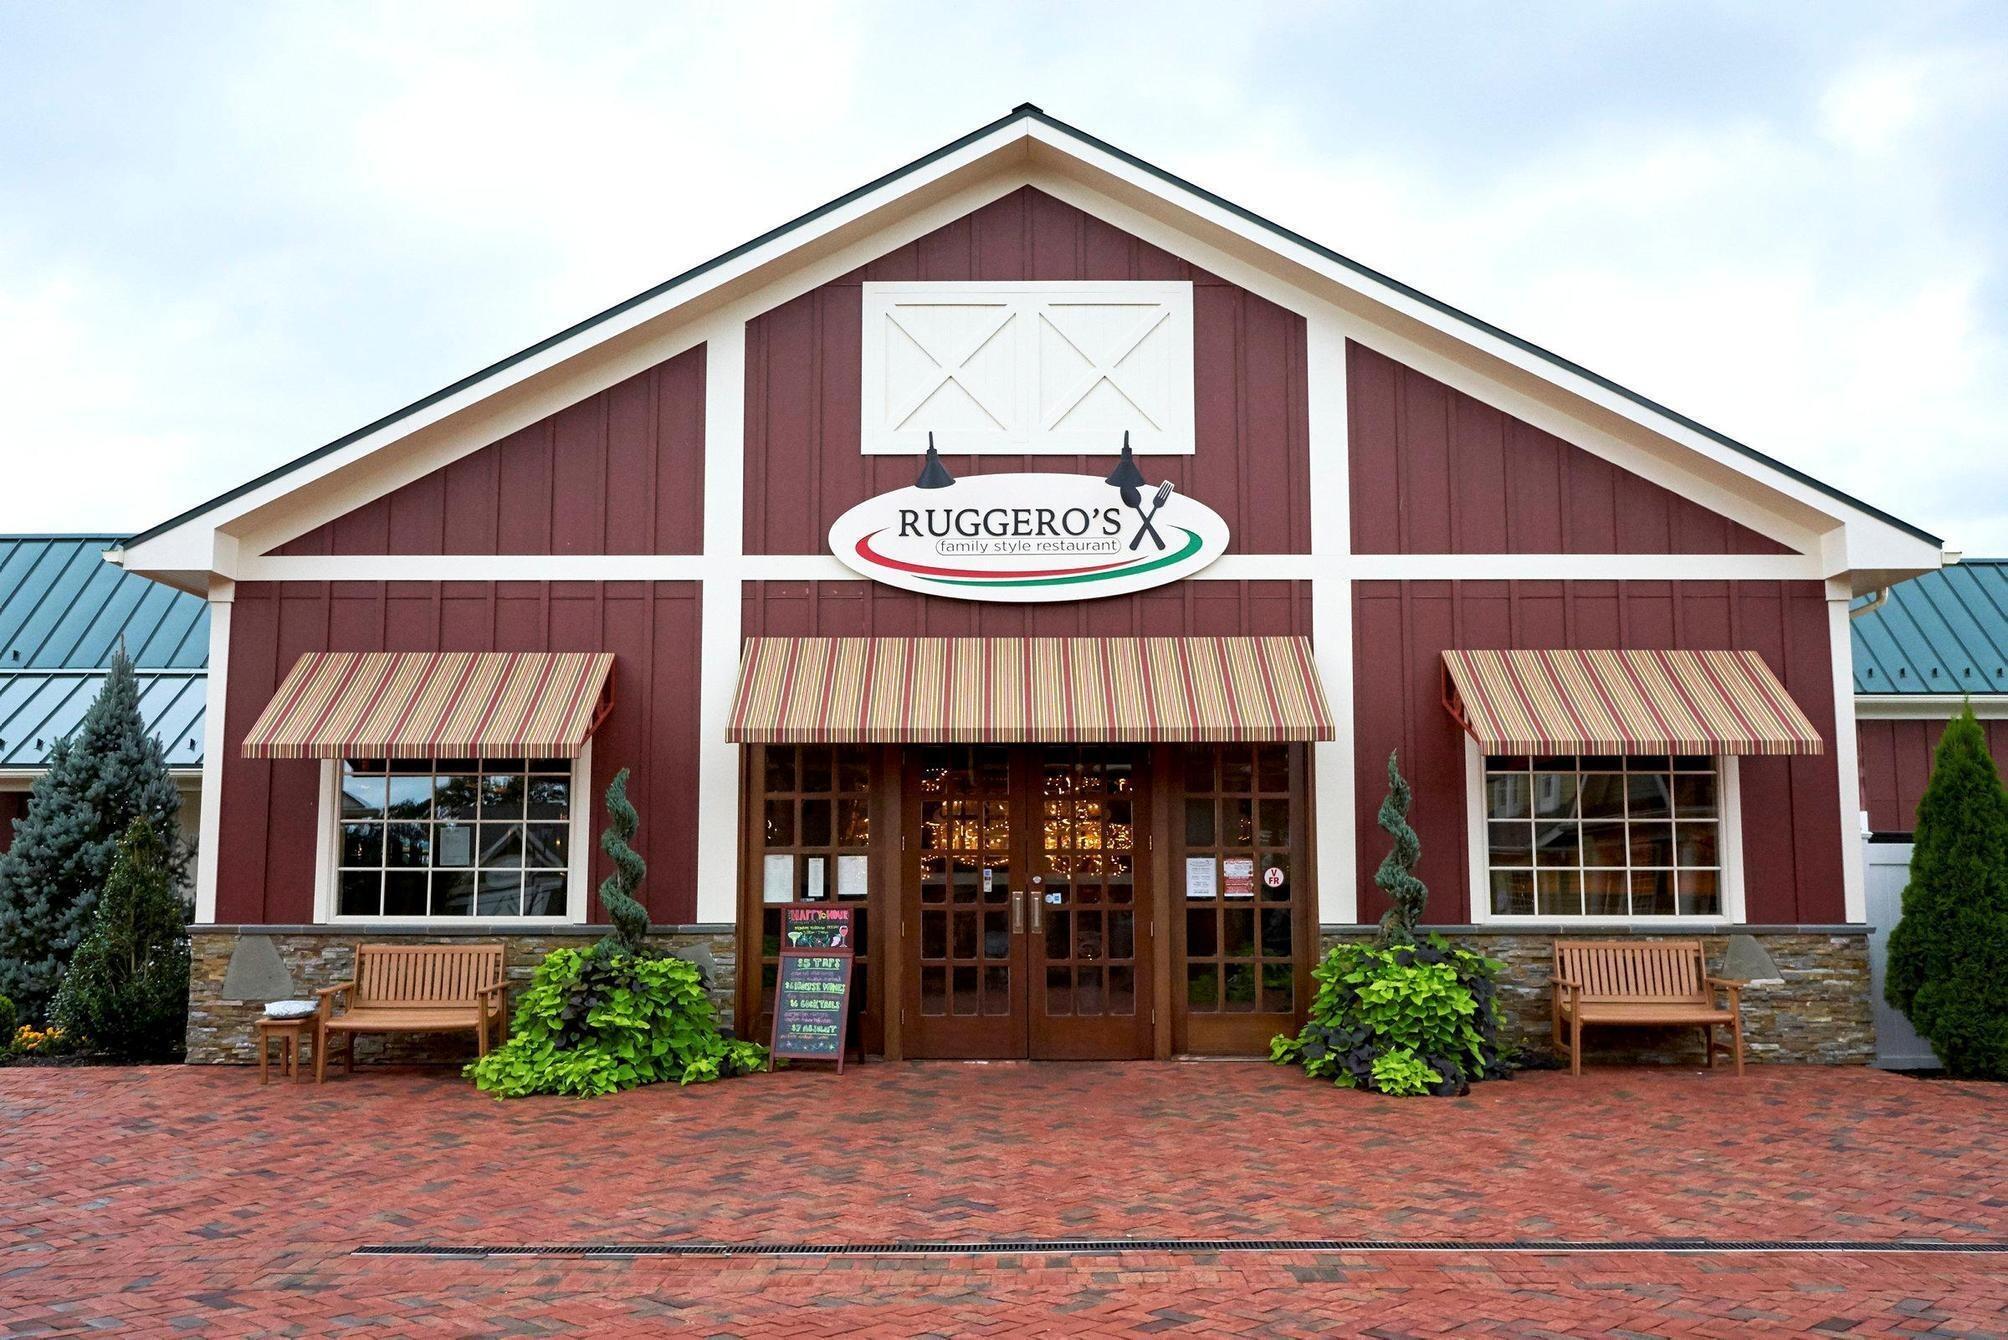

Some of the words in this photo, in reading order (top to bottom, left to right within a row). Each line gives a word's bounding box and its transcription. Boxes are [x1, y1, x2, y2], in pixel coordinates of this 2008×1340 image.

[898, 507, 1121, 536] RUGGERO'S
[940, 538, 988, 554] family
[994, 538, 1031, 553] style
[1036, 538, 1118, 551] restaurant
[1269, 877, 1280, 885] FR
